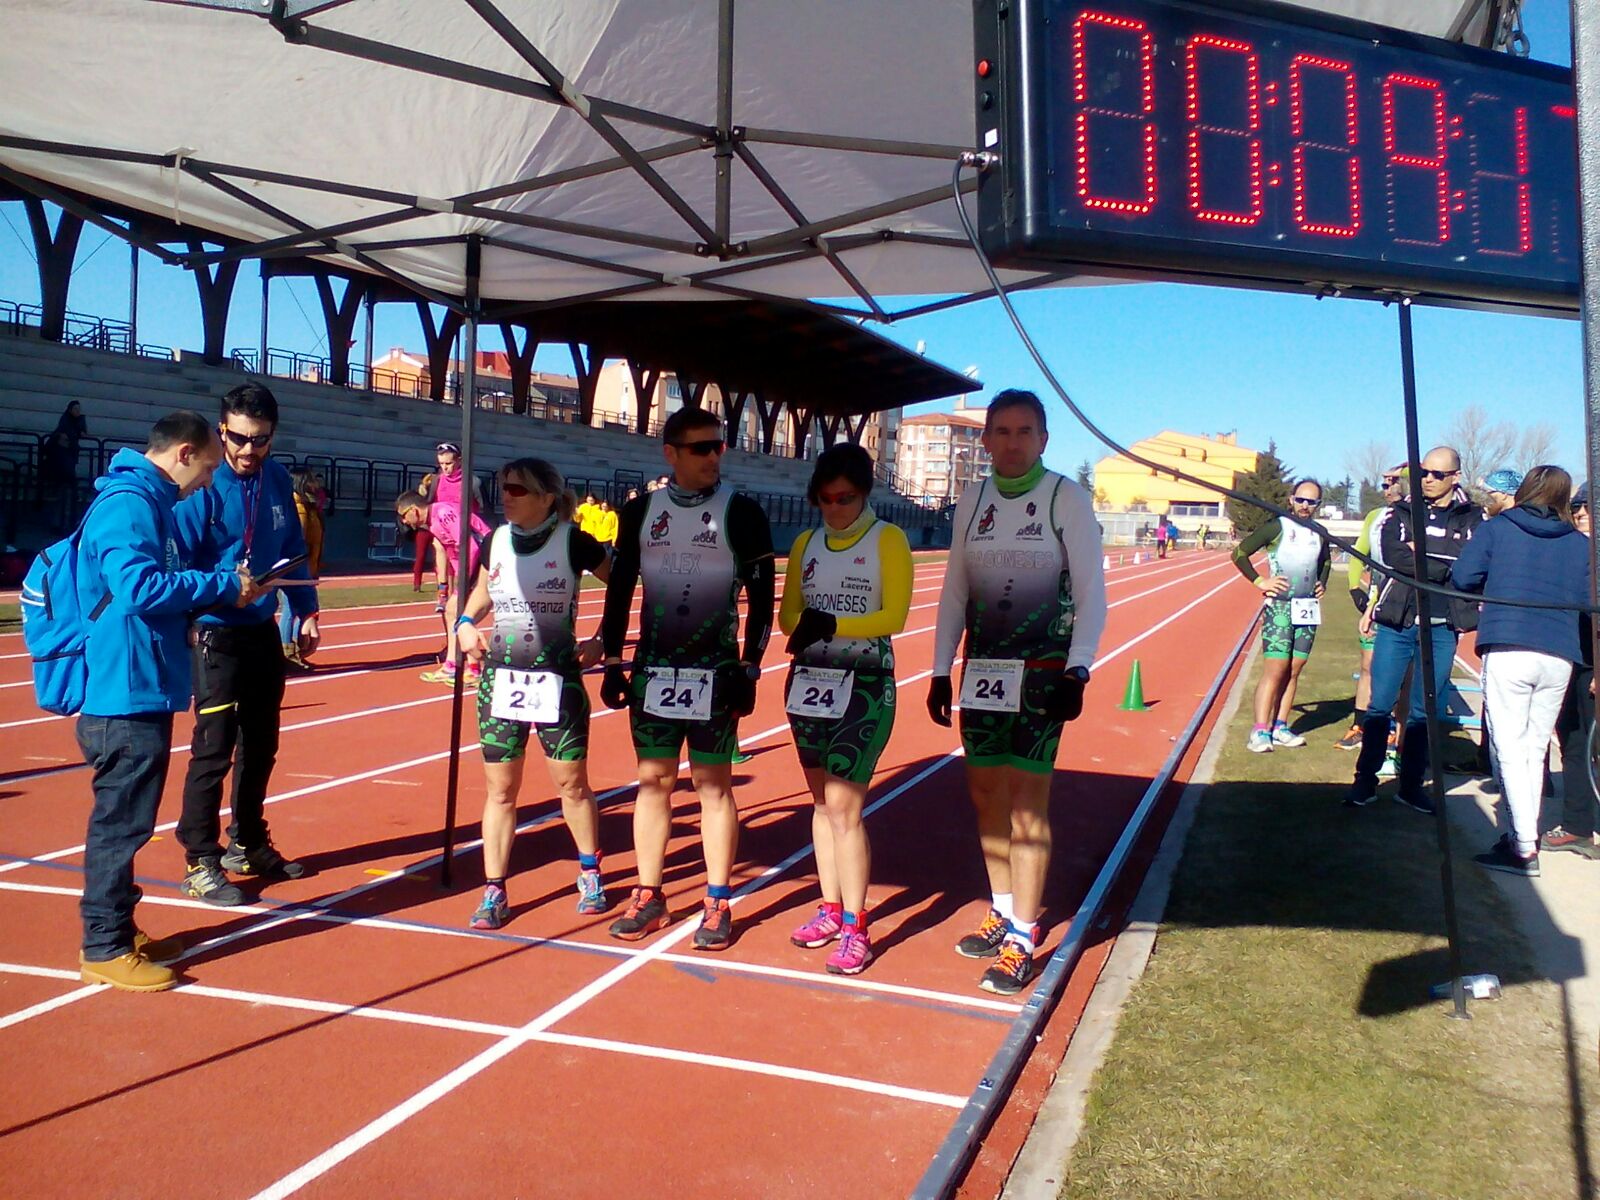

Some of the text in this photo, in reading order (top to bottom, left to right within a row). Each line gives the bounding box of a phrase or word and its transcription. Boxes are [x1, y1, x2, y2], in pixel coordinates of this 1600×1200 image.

[1073, 10, 1576, 257] 00:09:1
[659, 552, 702, 575] ALEX
[841, 581, 872, 592] Lacerta
[510, 597, 564, 614] Esperanza
[1300, 609, 1314, 619] 21
[659, 687, 693, 708] 24
[802, 687, 835, 708] 24
[975, 678, 1005, 700] 24
[509, 690, 543, 710] 24
